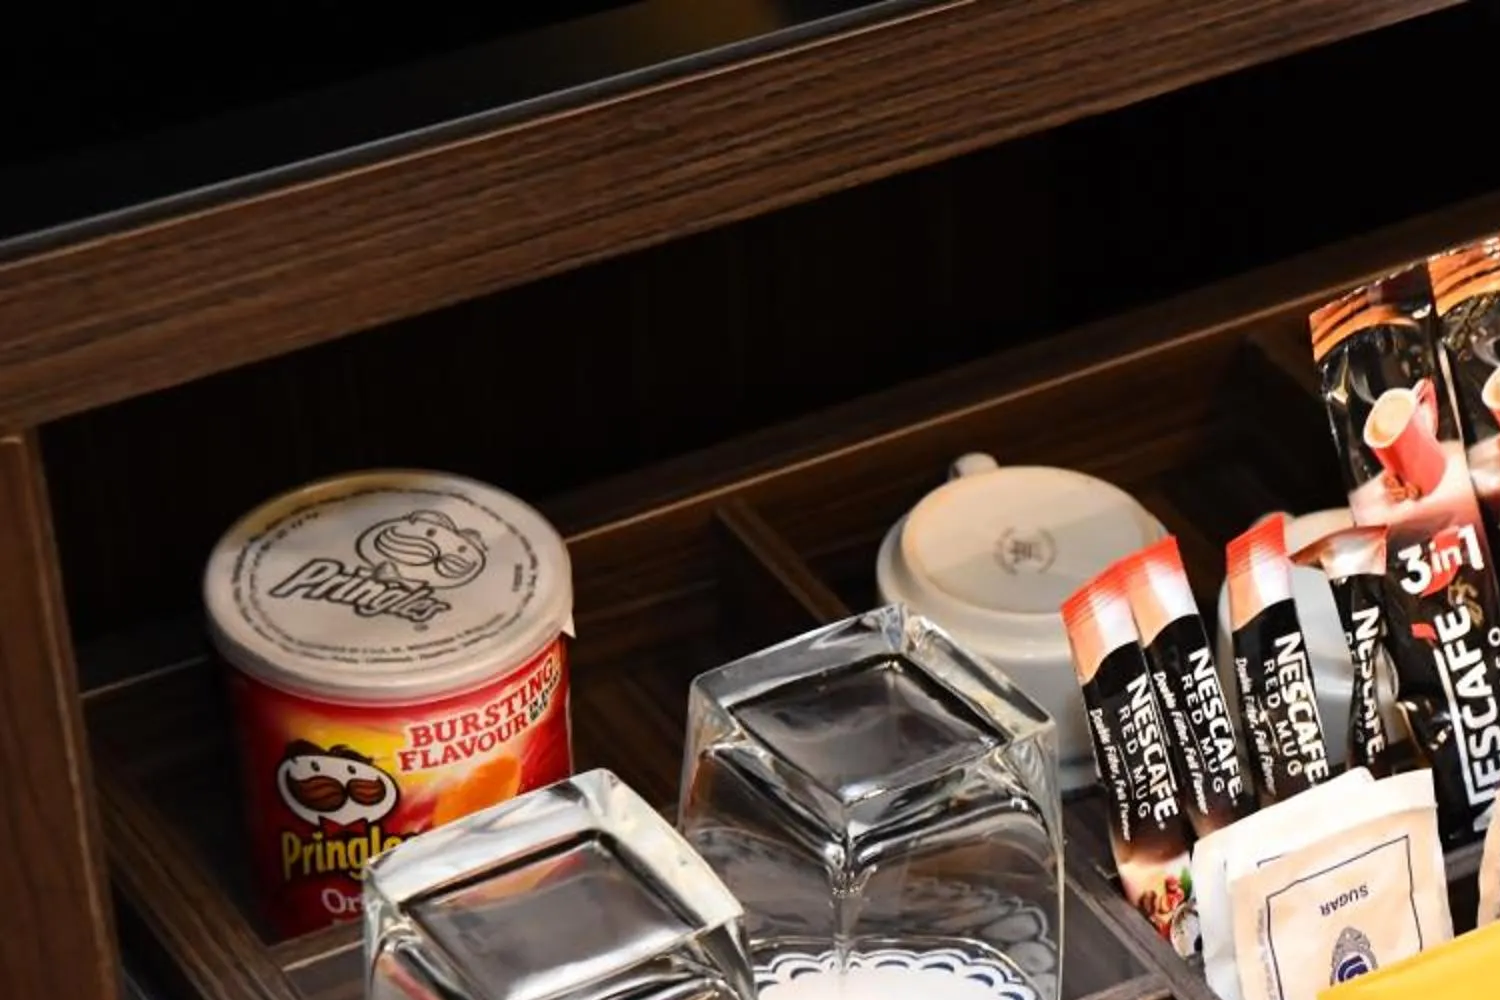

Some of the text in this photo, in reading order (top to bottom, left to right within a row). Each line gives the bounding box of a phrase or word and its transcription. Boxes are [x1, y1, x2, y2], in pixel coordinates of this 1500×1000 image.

[269, 558, 452, 623] Pringles
[1398, 524, 1484, 595] 3in1
[410, 657, 556, 748] BURSTING
[1181, 674, 1224, 793] RED MUG
[1264, 660, 1302, 776] RED MUG
[399, 714, 529, 772] FLAVOUR
[1118, 705, 1151, 819] RED MUG
[282, 826, 405, 881] Pringl
[1319, 884, 1369, 918] SUGAR
